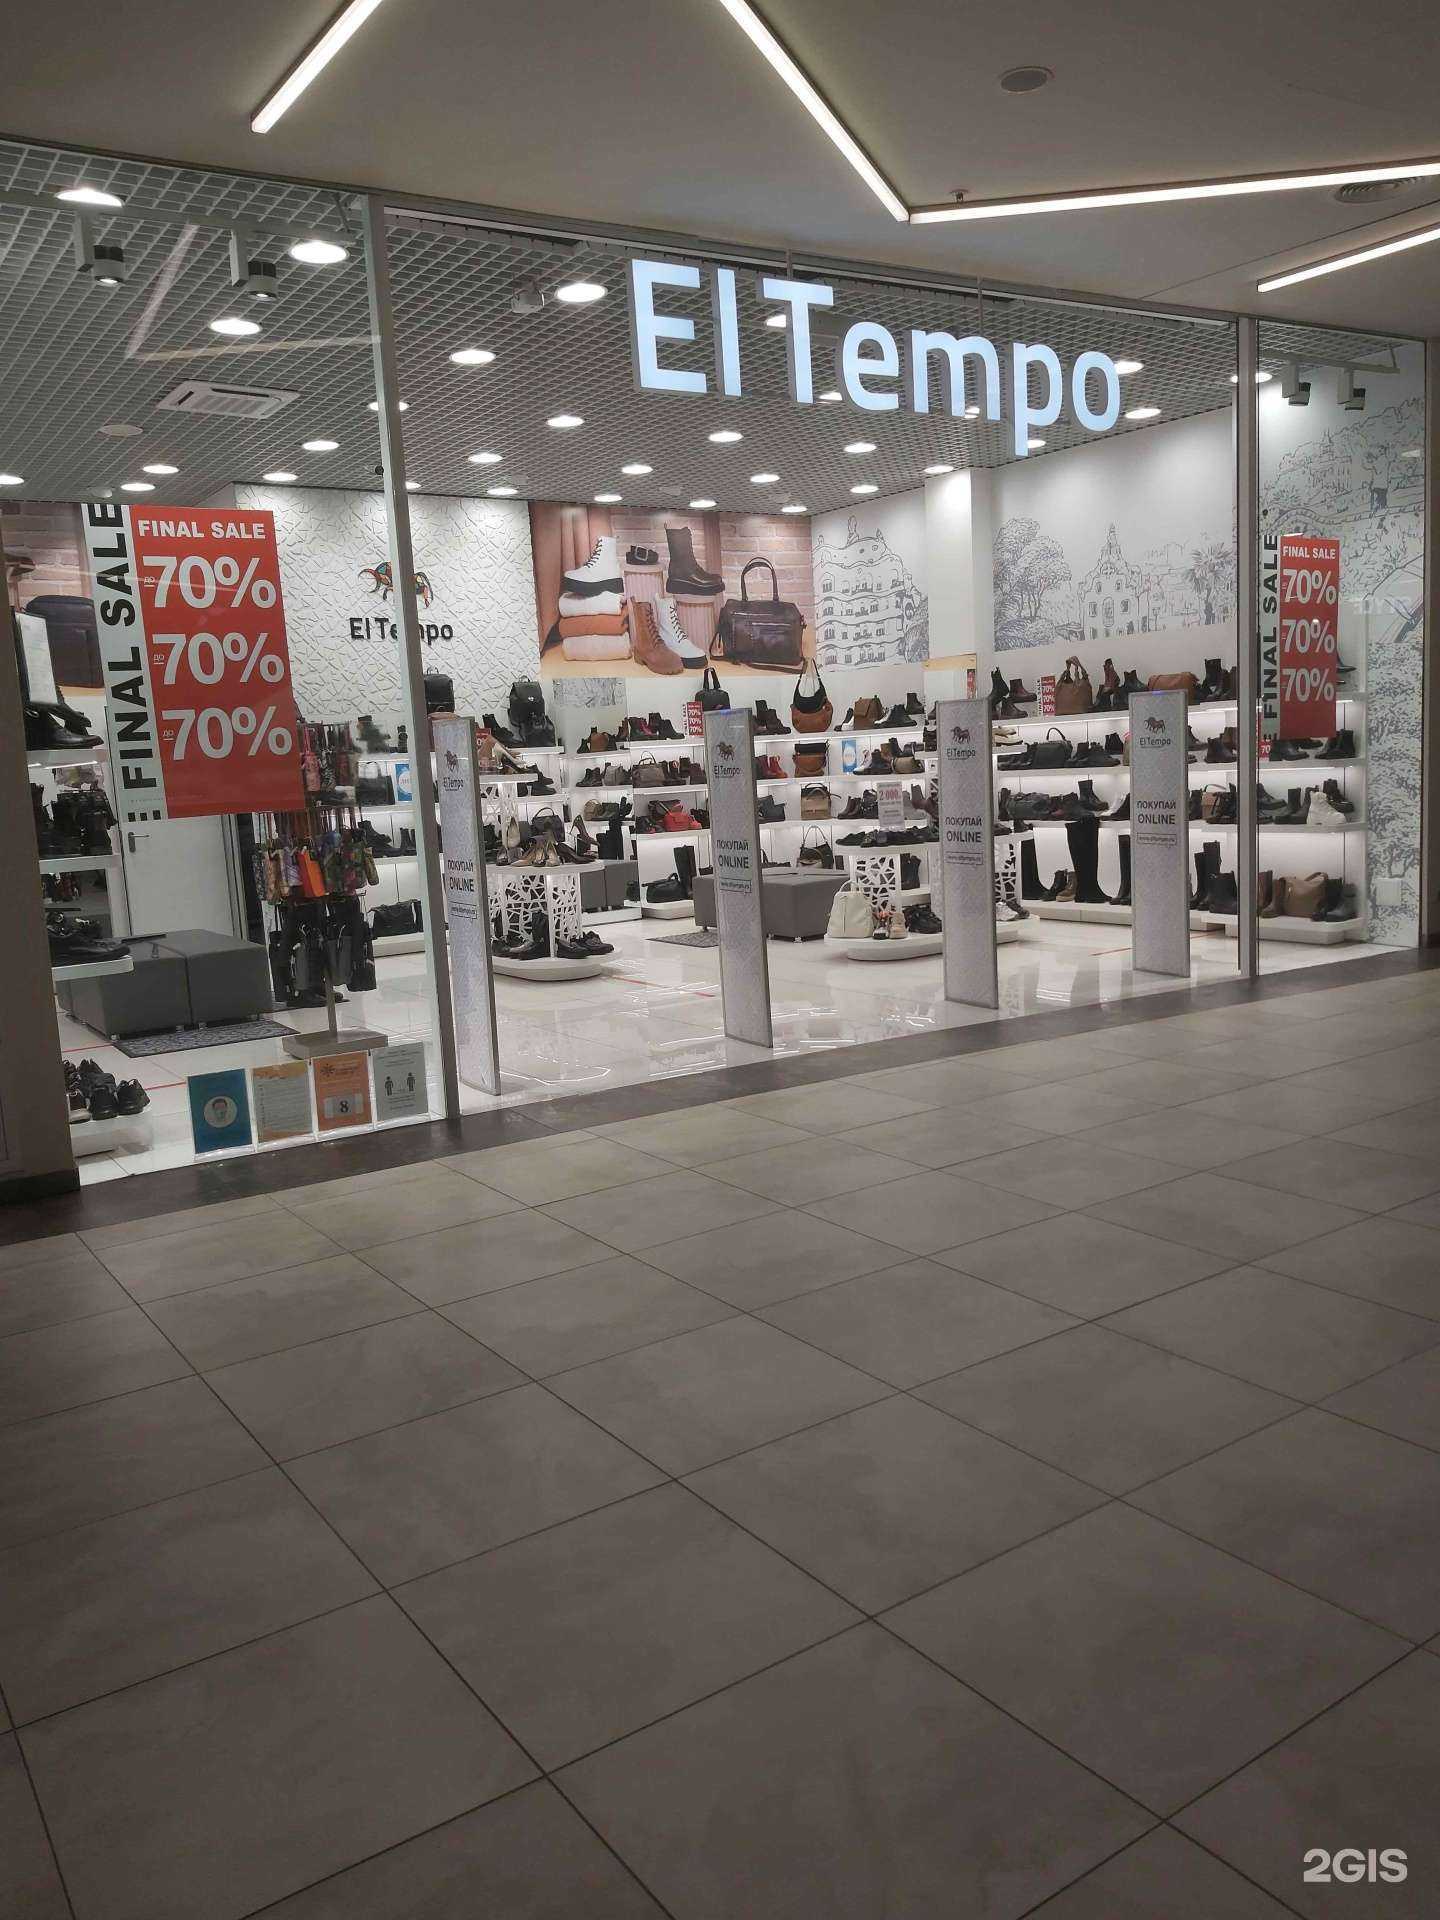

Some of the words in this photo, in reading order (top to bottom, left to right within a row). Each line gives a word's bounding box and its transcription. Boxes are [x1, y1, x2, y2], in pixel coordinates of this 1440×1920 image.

[631, 259, 742, 398] El
[761, 277, 1121, 457] Tempo
[137, 519, 205, 539] FINAL
[211, 521, 266, 540] SALE
[87, 503, 136, 627] SALE
[1282, 545, 1310, 558] FINAL
[1312, 547, 1337, 560] SALE
[142, 555, 277, 609] 70%
[1262, 534, 1278, 614] SALE
[1282, 568, 1337, 605] 70%
[349, 617, 371, 640] El
[1282, 618, 1336, 653] 70%
[152, 632, 285, 685] 70%
[1263, 626, 1278, 719] FINAL
[1282, 667, 1335, 702] 70%
[106, 645, 158, 790] FINAL
[161, 705, 293, 761] 70%
[1137, 800, 1176, 809] ПОКУПАЙ
[1137, 813, 1176, 825] ONLINE
[945, 816, 982, 826] ПОКУПАЙ
[716, 839, 748, 850] ПОКУПАЙ
[946, 830, 982, 842] ONLINE
[447, 859, 474, 872] ПОКУПАЙ
[718, 855, 749, 868] ONLINE
[449, 877, 475, 892] ONLINE
